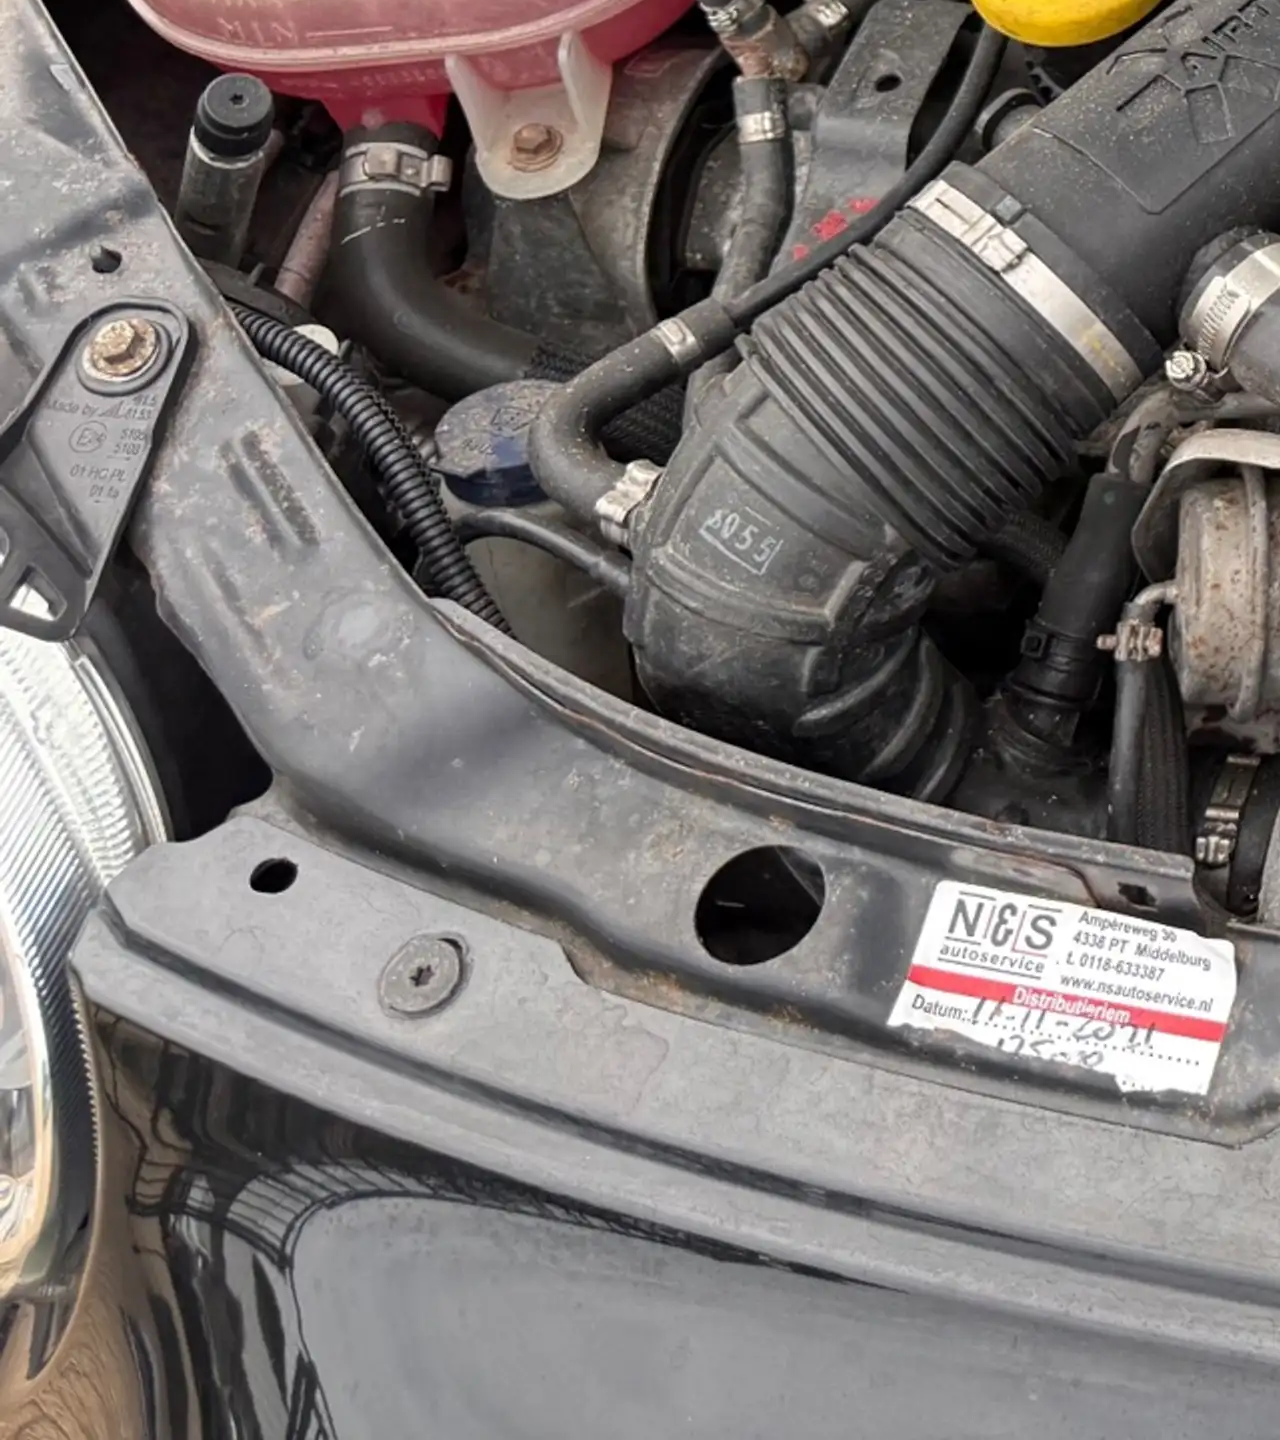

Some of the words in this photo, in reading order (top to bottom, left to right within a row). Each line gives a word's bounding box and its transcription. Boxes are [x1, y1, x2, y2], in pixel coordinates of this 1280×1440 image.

[948, 898, 1058, 951] N&S
[939, 941, 1046, 975] autoservice
[1078, 953, 1166, 983] 0118-633387
[1107, 937, 1129, 954] PT
[1133, 941, 1213, 973] Middelburg
[1059, 973, 1215, 1015] www.nsautoservice.nl
